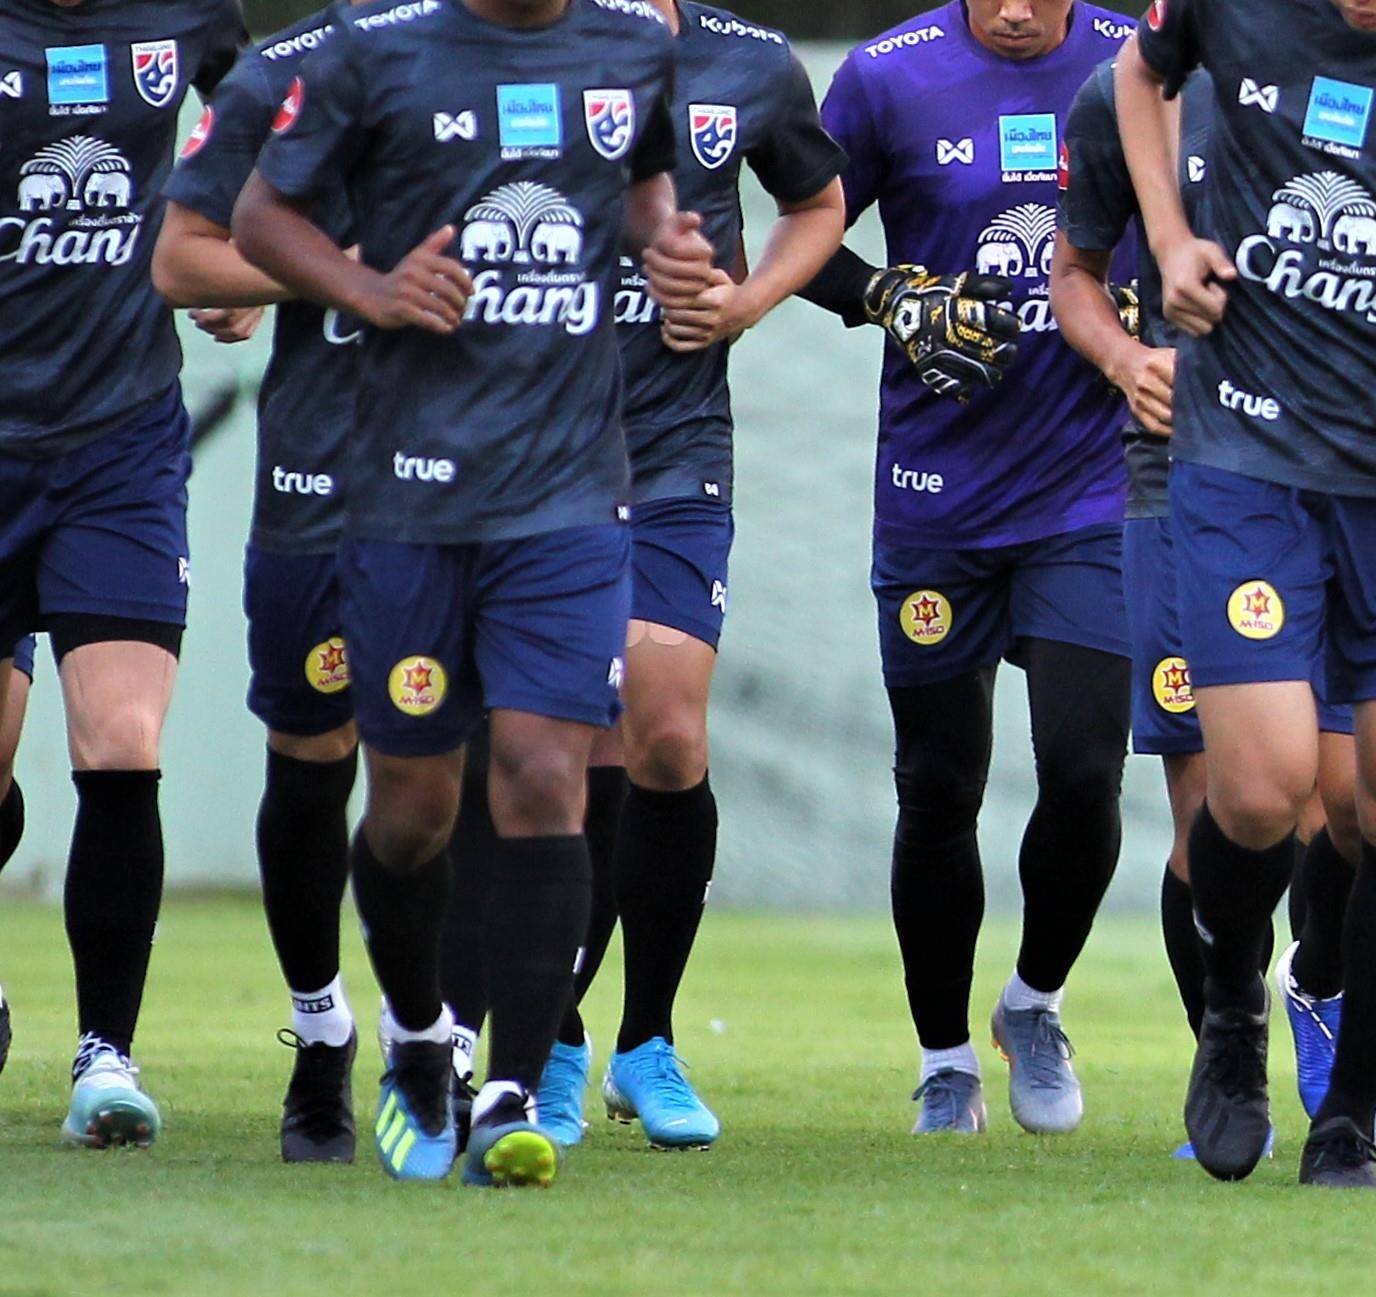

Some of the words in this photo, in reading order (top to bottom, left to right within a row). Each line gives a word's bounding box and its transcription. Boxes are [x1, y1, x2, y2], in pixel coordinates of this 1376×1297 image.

[354, 0, 438, 30] TOYOTA
[1095, 19, 1138, 39] Kub
[701, 16, 783, 44] Kubota
[865, 26, 944, 57] TOYOTA
[463, 264, 597, 334] hang
[1219, 381, 1279, 419] true
[273, 466, 332, 494] true
[394, 452, 454, 481] true
[893, 464, 943, 493] true
